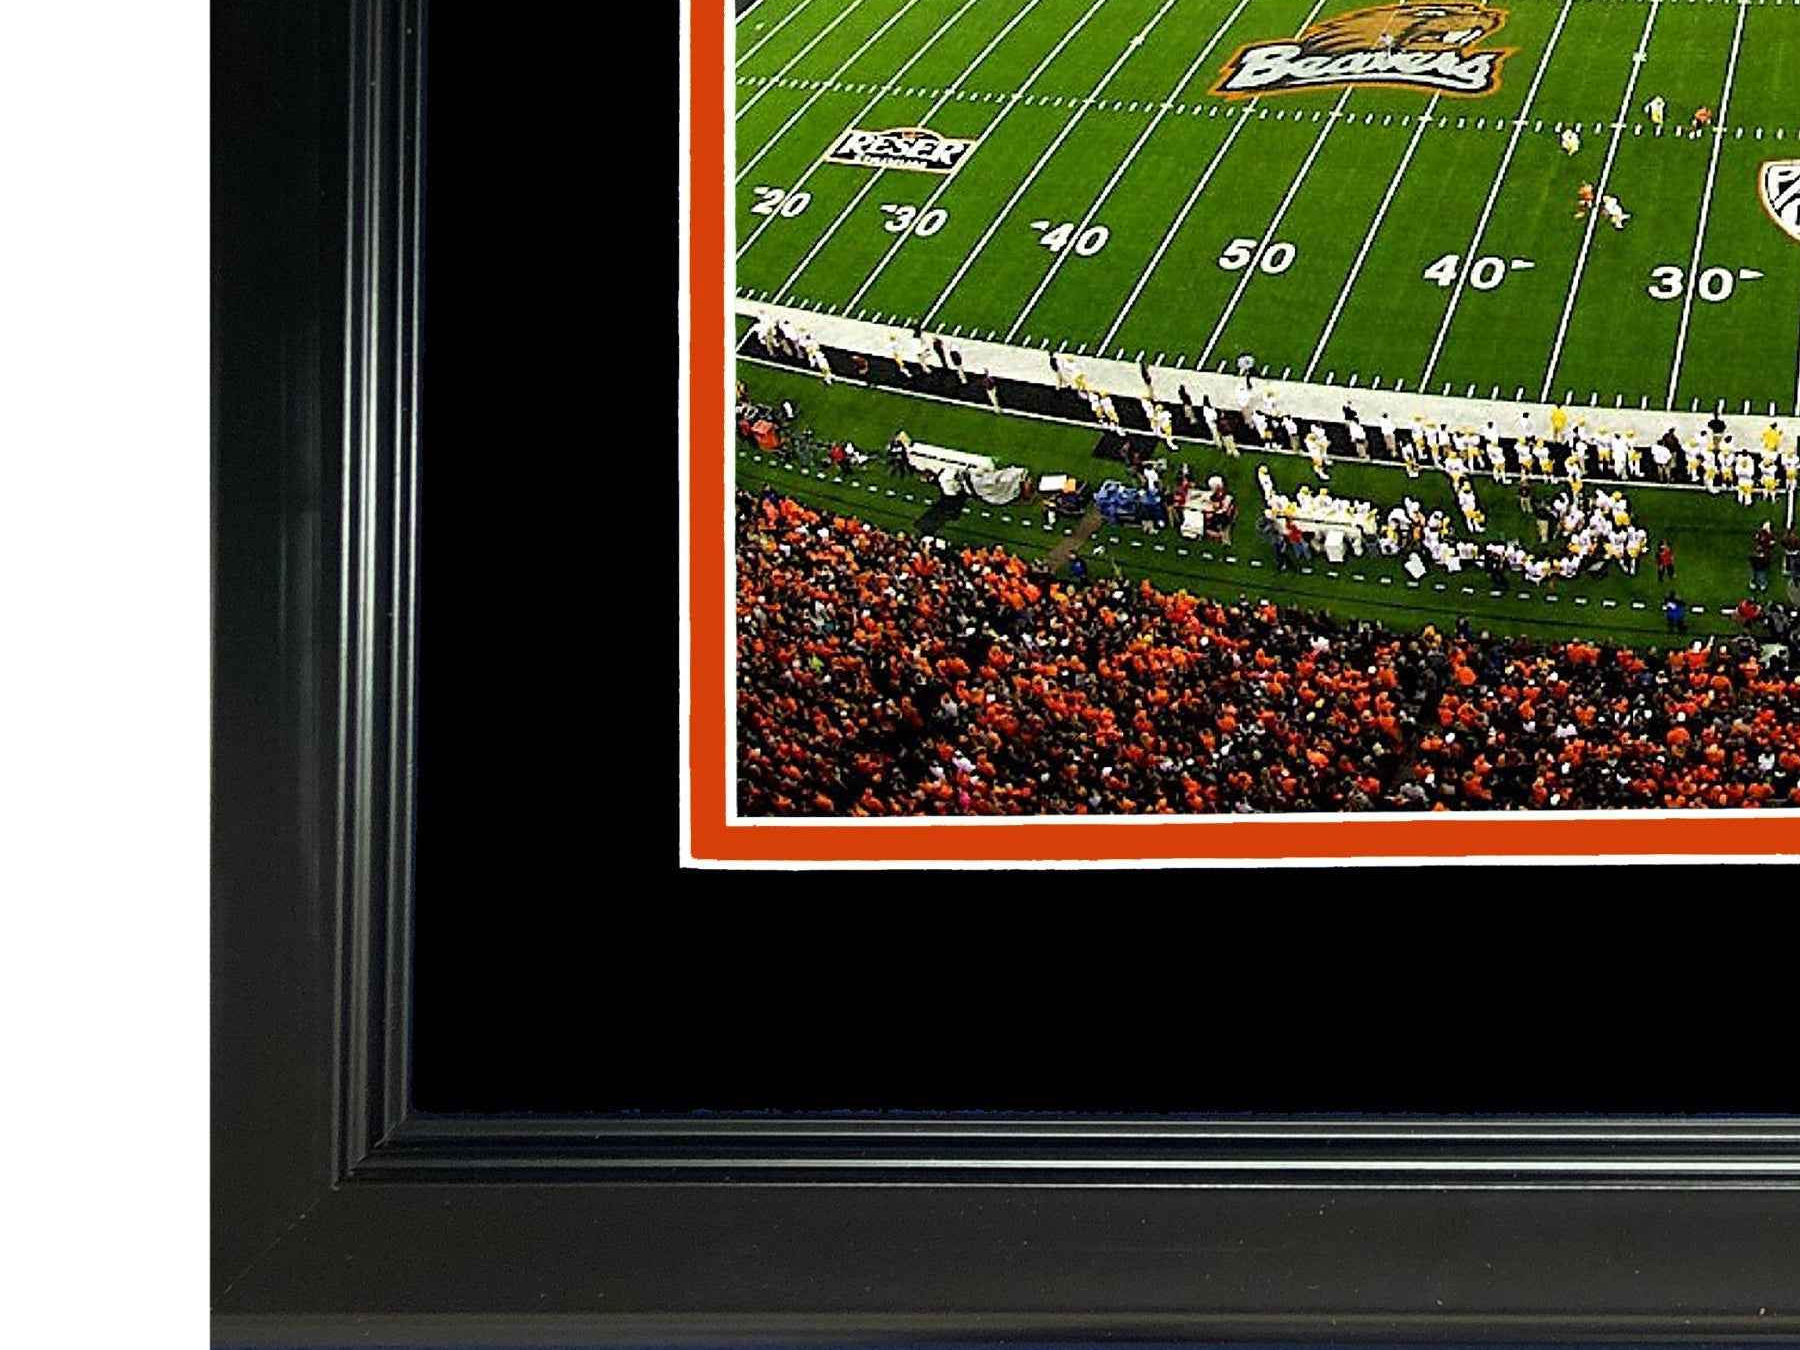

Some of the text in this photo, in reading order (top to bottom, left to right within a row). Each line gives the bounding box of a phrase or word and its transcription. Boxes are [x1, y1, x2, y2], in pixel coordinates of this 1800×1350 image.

[1225, 43, 1498, 91] Beavers
[836, 134, 967, 165] RESER
[751, 188, 812, 218] 20
[884, 205, 948, 237] 30
[1039, 221, 1110, 257] 40
[1217, 238, 1297, 274] 50
[1422, 253, 1508, 290] 40
[1647, 265, 1736, 302] 30
